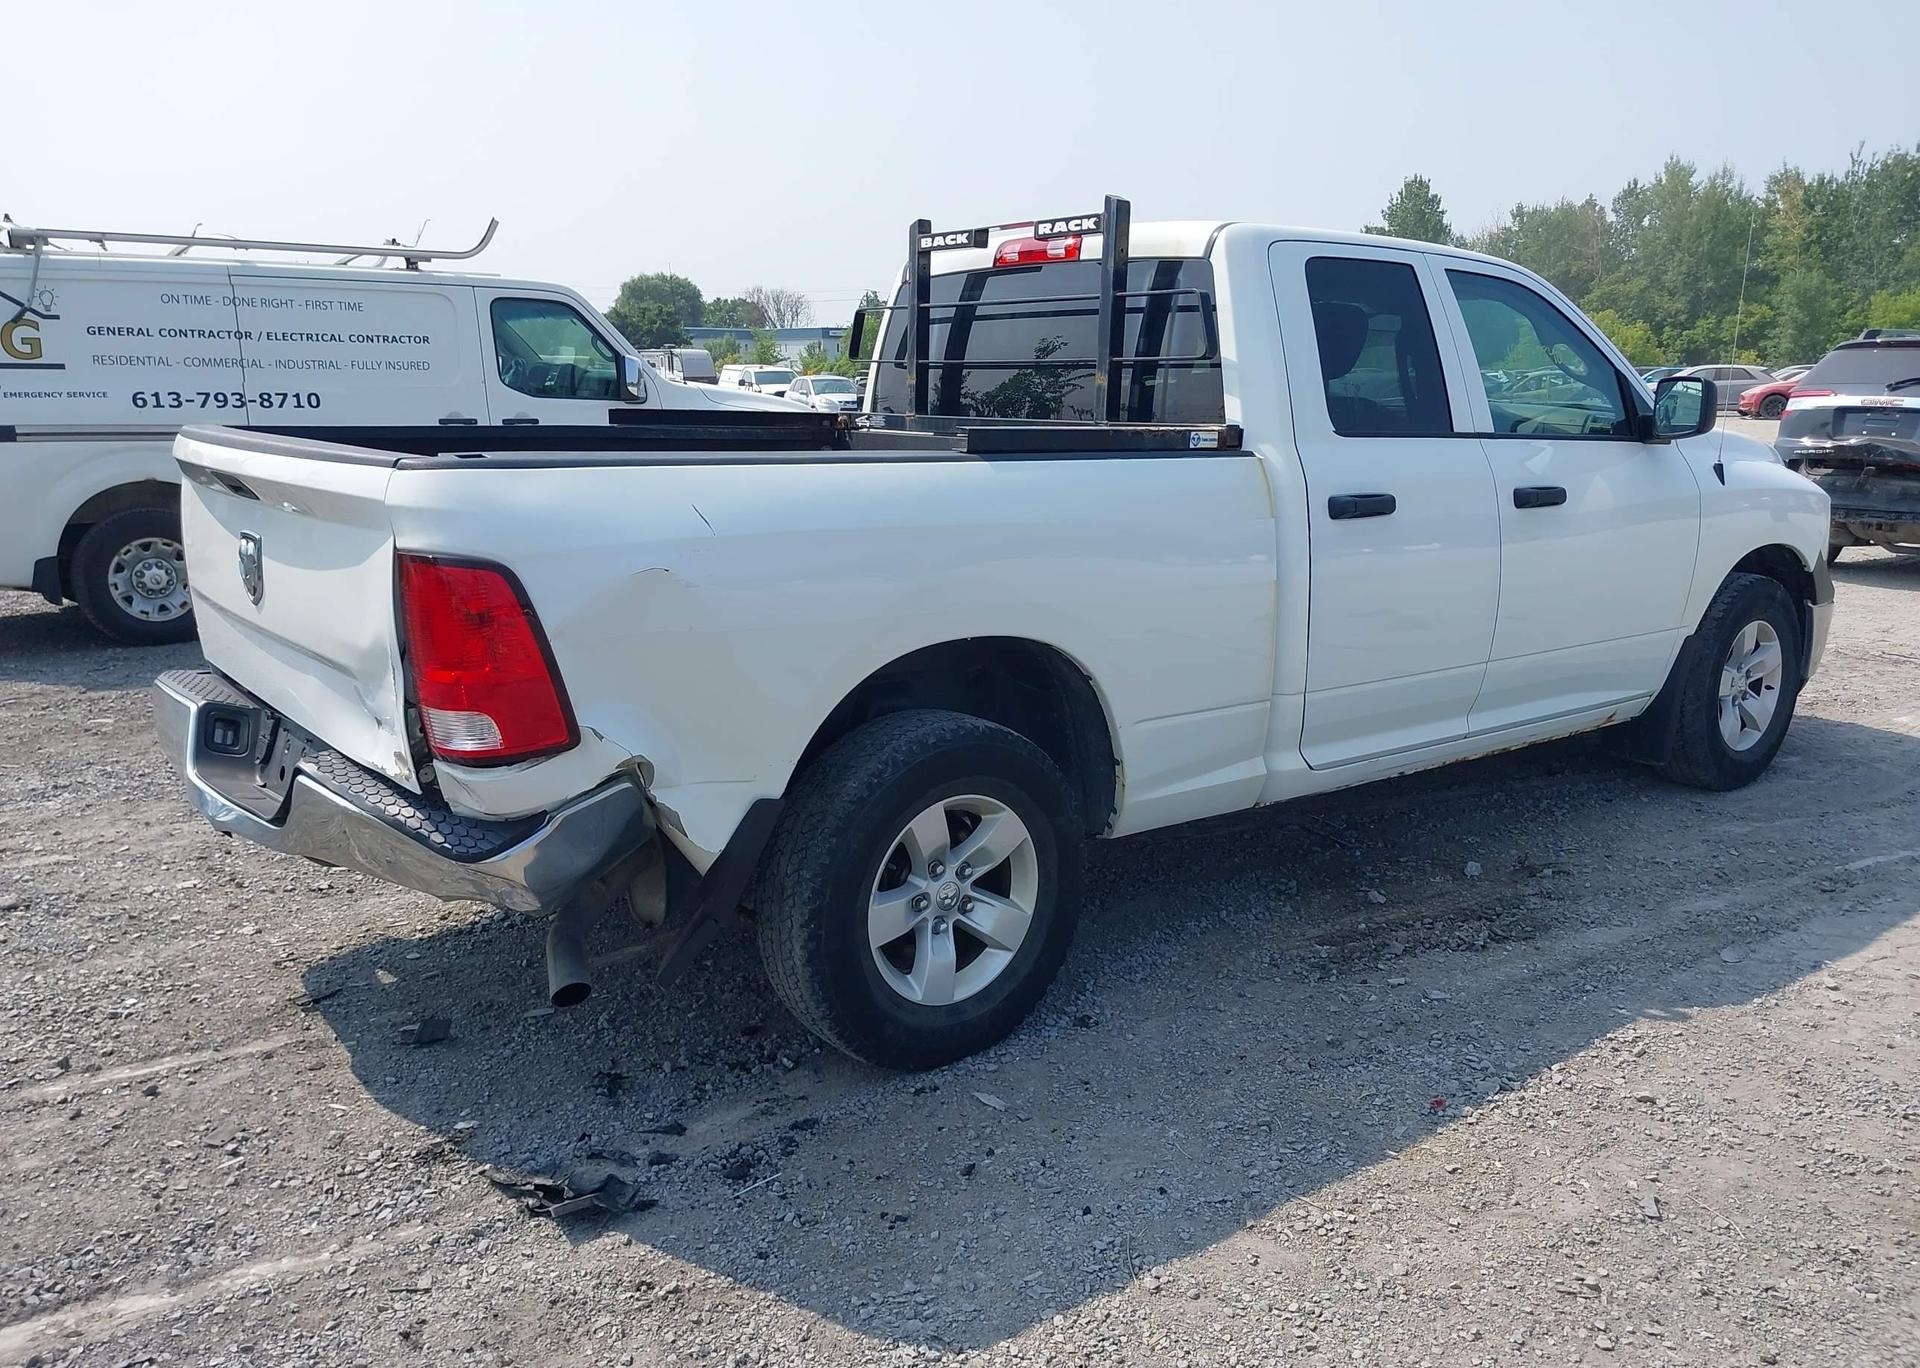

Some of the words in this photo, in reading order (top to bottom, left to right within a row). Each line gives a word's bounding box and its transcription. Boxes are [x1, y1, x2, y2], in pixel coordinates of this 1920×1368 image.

[1037, 218, 1098, 235] RACK
[920, 232, 969, 249] BACK
[160, 293, 179, 305] ON
[180, 294, 212, 306] TIME
[222, 296, 258, 308] DONE
[260, 298, 295, 309] RIGHT
[305, 299, 335, 311] FIRST
[338, 300, 364, 312] TIME
[0, 317, 43, 360] G
[86, 325, 154, 338] GENERAL
[158, 327, 253, 341] CONTRACTOR
[266, 331, 345, 343] ELECTRICAL
[348, 334, 431, 345] CONTRACTOR
[92, 354, 173, 367] RESIDENTIAL
[183, 356, 264, 369] COMMERCIAL
[275, 358, 342, 370] INDUSTRIAL
[351, 359, 382, 371] FULLY
[385, 360, 431, 371] INSURED
[3, 391, 63, 399] EMERGENCY
[66, 391, 109, 399] SERVICE
[131, 391, 321, 409] 613-793-8710
[1860, 398, 1905, 407] GMC
